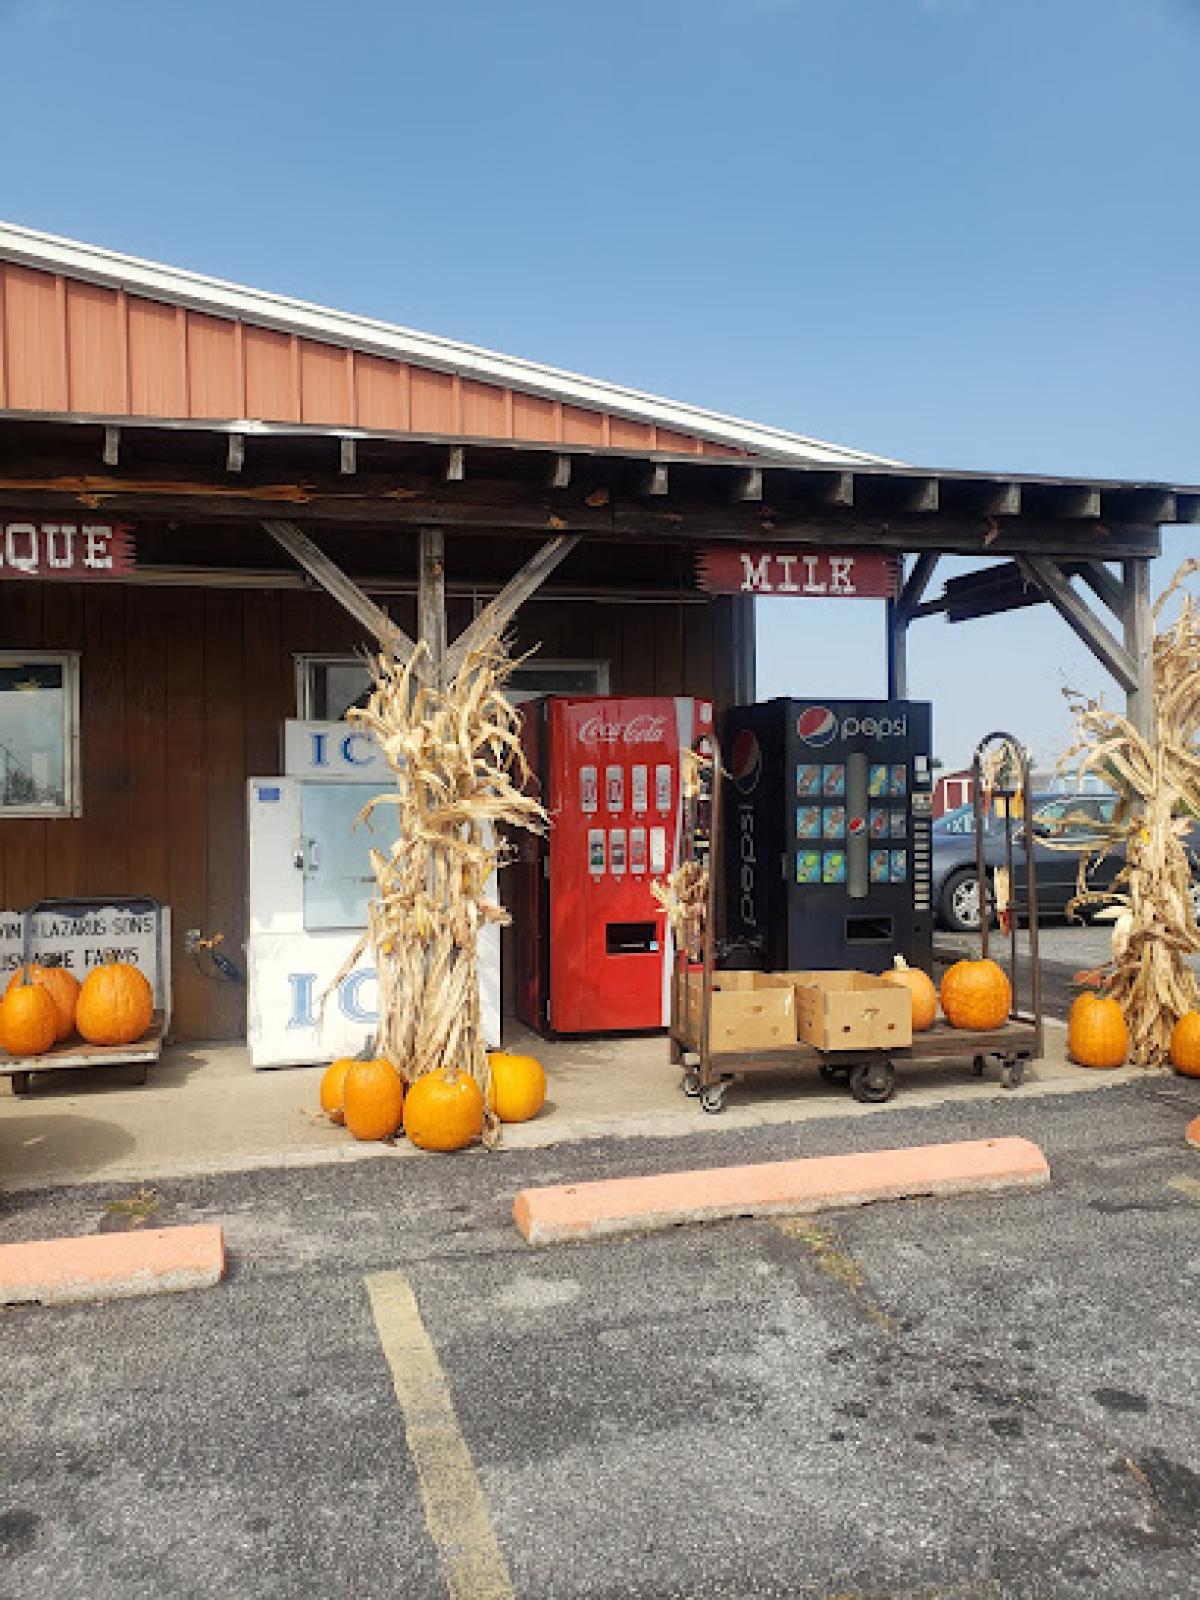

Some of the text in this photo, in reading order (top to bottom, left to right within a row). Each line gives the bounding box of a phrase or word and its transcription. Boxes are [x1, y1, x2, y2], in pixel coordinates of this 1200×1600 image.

[0, 523, 112, 573] QUE
[740, 553, 856, 592] MILK
[841, 714, 907, 741] pepsi
[309, 731, 403, 767] IC
[738, 804, 757, 927] pepsi
[41, 920, 106, 938] LAZARUS
[112, 917, 153, 935] SONS
[288, 968, 381, 1030] IC
